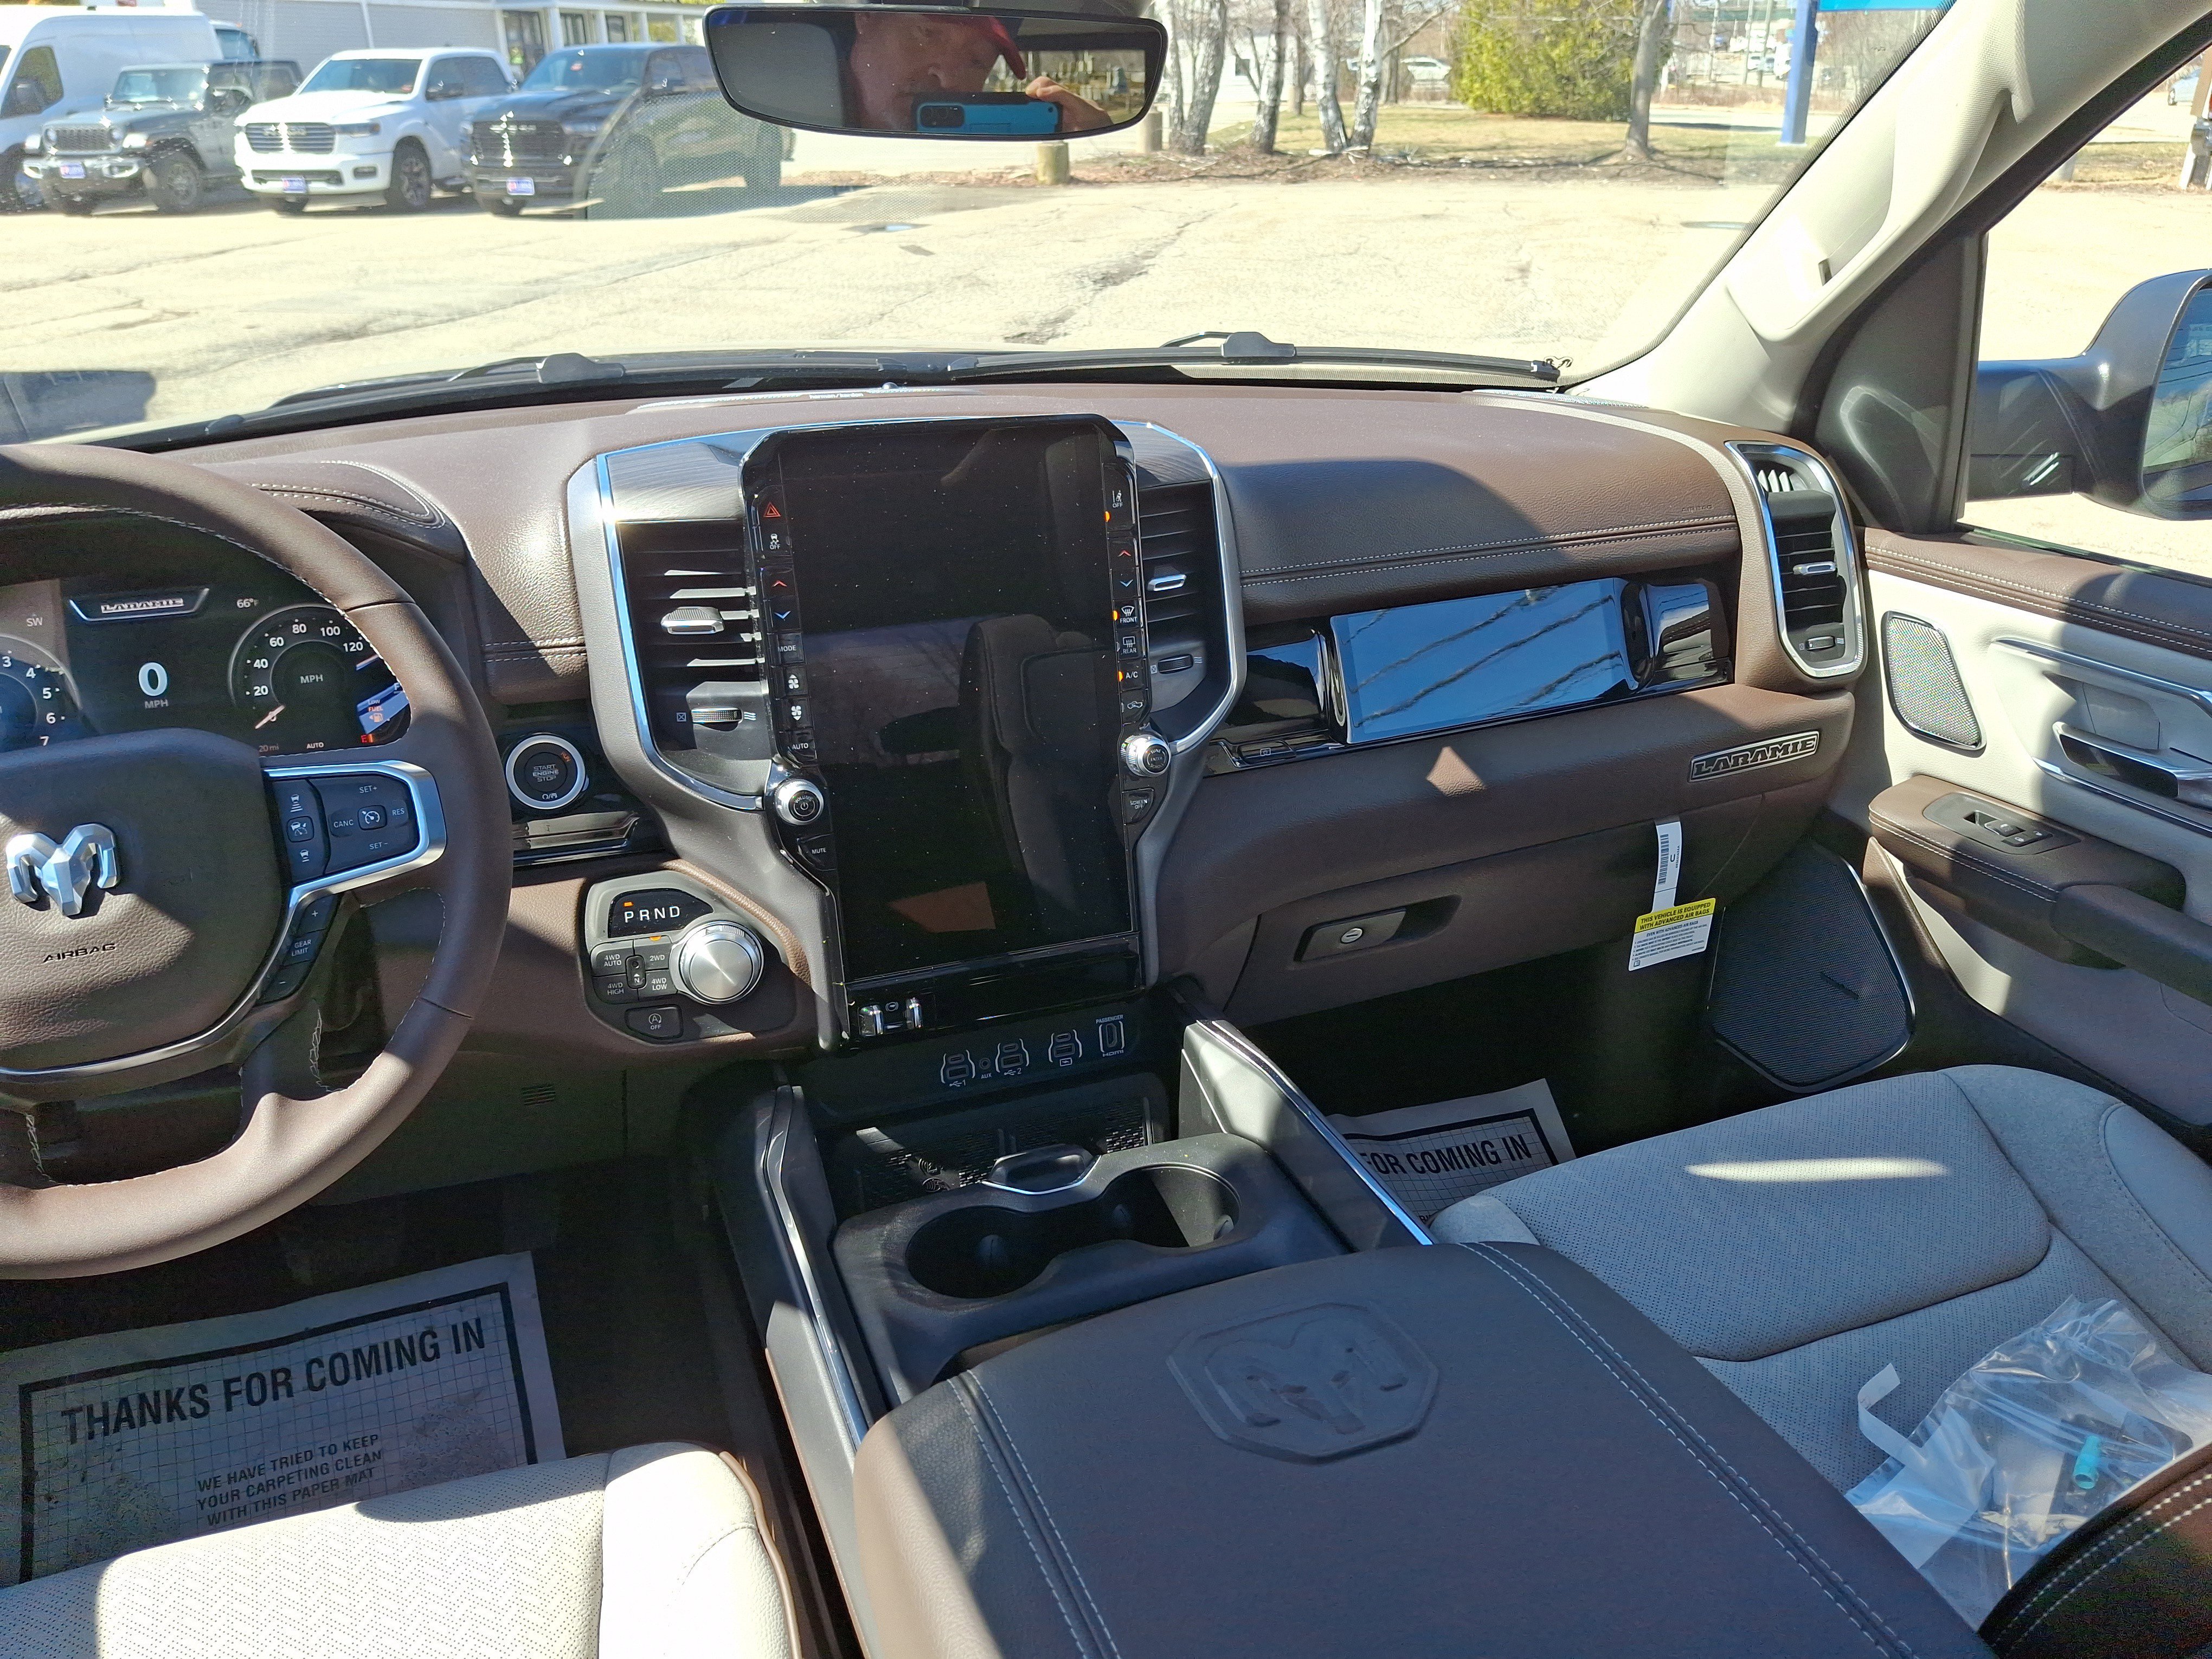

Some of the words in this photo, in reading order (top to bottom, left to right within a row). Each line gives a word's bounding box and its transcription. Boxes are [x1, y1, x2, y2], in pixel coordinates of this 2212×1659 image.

[27, 617, 43, 627] SW
[292, 623, 307, 634] 80
[320, 626, 340, 637] 100
[269, 636, 284, 647] 60
[343, 641, 363, 652] 120
[2, 656, 12, 667] 3
[253, 658, 268, 669] 40
[25, 667, 36, 679] 4
[138, 661, 168, 697] 0
[300, 674, 324, 684] MPH
[42, 687, 52, 699] 5
[253, 685, 268, 697] 20
[144, 699, 169, 709] MPH
[46, 712, 56, 725] 6
[40, 735, 50, 747] 7
[361, 734, 368, 743] E
[792, 742, 809, 750] AUTO
[1692, 735, 1818, 779] LARAMIE
[532, 769, 560, 777] ENGINE
[794, 795, 813, 803] VOLUME
[392, 808, 406, 816] RES
[333, 819, 354, 828] CANC
[1641, 916, 1653, 924] THIS
[1654, 910, 1676, 921] VEHICLE
[1683, 902, 1711, 914] EQUIPPED
[1654, 915, 1684, 927] ADVANCED
[294, 939, 312, 949] GEAR
[43, 943, 117, 963] AIRBAG
[291, 947, 308, 957] LIMIT
[603, 959, 622, 967] AUTO
[607, 988, 624, 996] HIGH
[652, 983, 667, 991] LOW
[1096, 1014, 1124, 1024] PASSENGER
[1405, 1140, 1502, 1175] COMING
[1501, 1134, 1532, 1161] IN
[60, 1383, 211, 1445] THANKS
[222, 1367, 294, 1412] FOR
[305, 1329, 441, 1392] COMING
[452, 1317, 485, 1355] IN
[197, 1474, 222, 1493] WE
[227, 1463, 266, 1486] HAVE
[270, 1449, 313, 1471] TRIED
[318, 1443, 337, 1457] TO
[342, 1434, 378, 1454] KEEP
[196, 1488, 241, 1511] YOUR
[246, 1462, 329, 1497] CARPETING
[335, 1450, 382, 1472] CLEAN
[207, 1503, 247, 1527] WITH
[252, 1494, 287, 1512] THIS
[291, 1478, 340, 1501] PAPER
[344, 1467, 375, 1487] MAT
